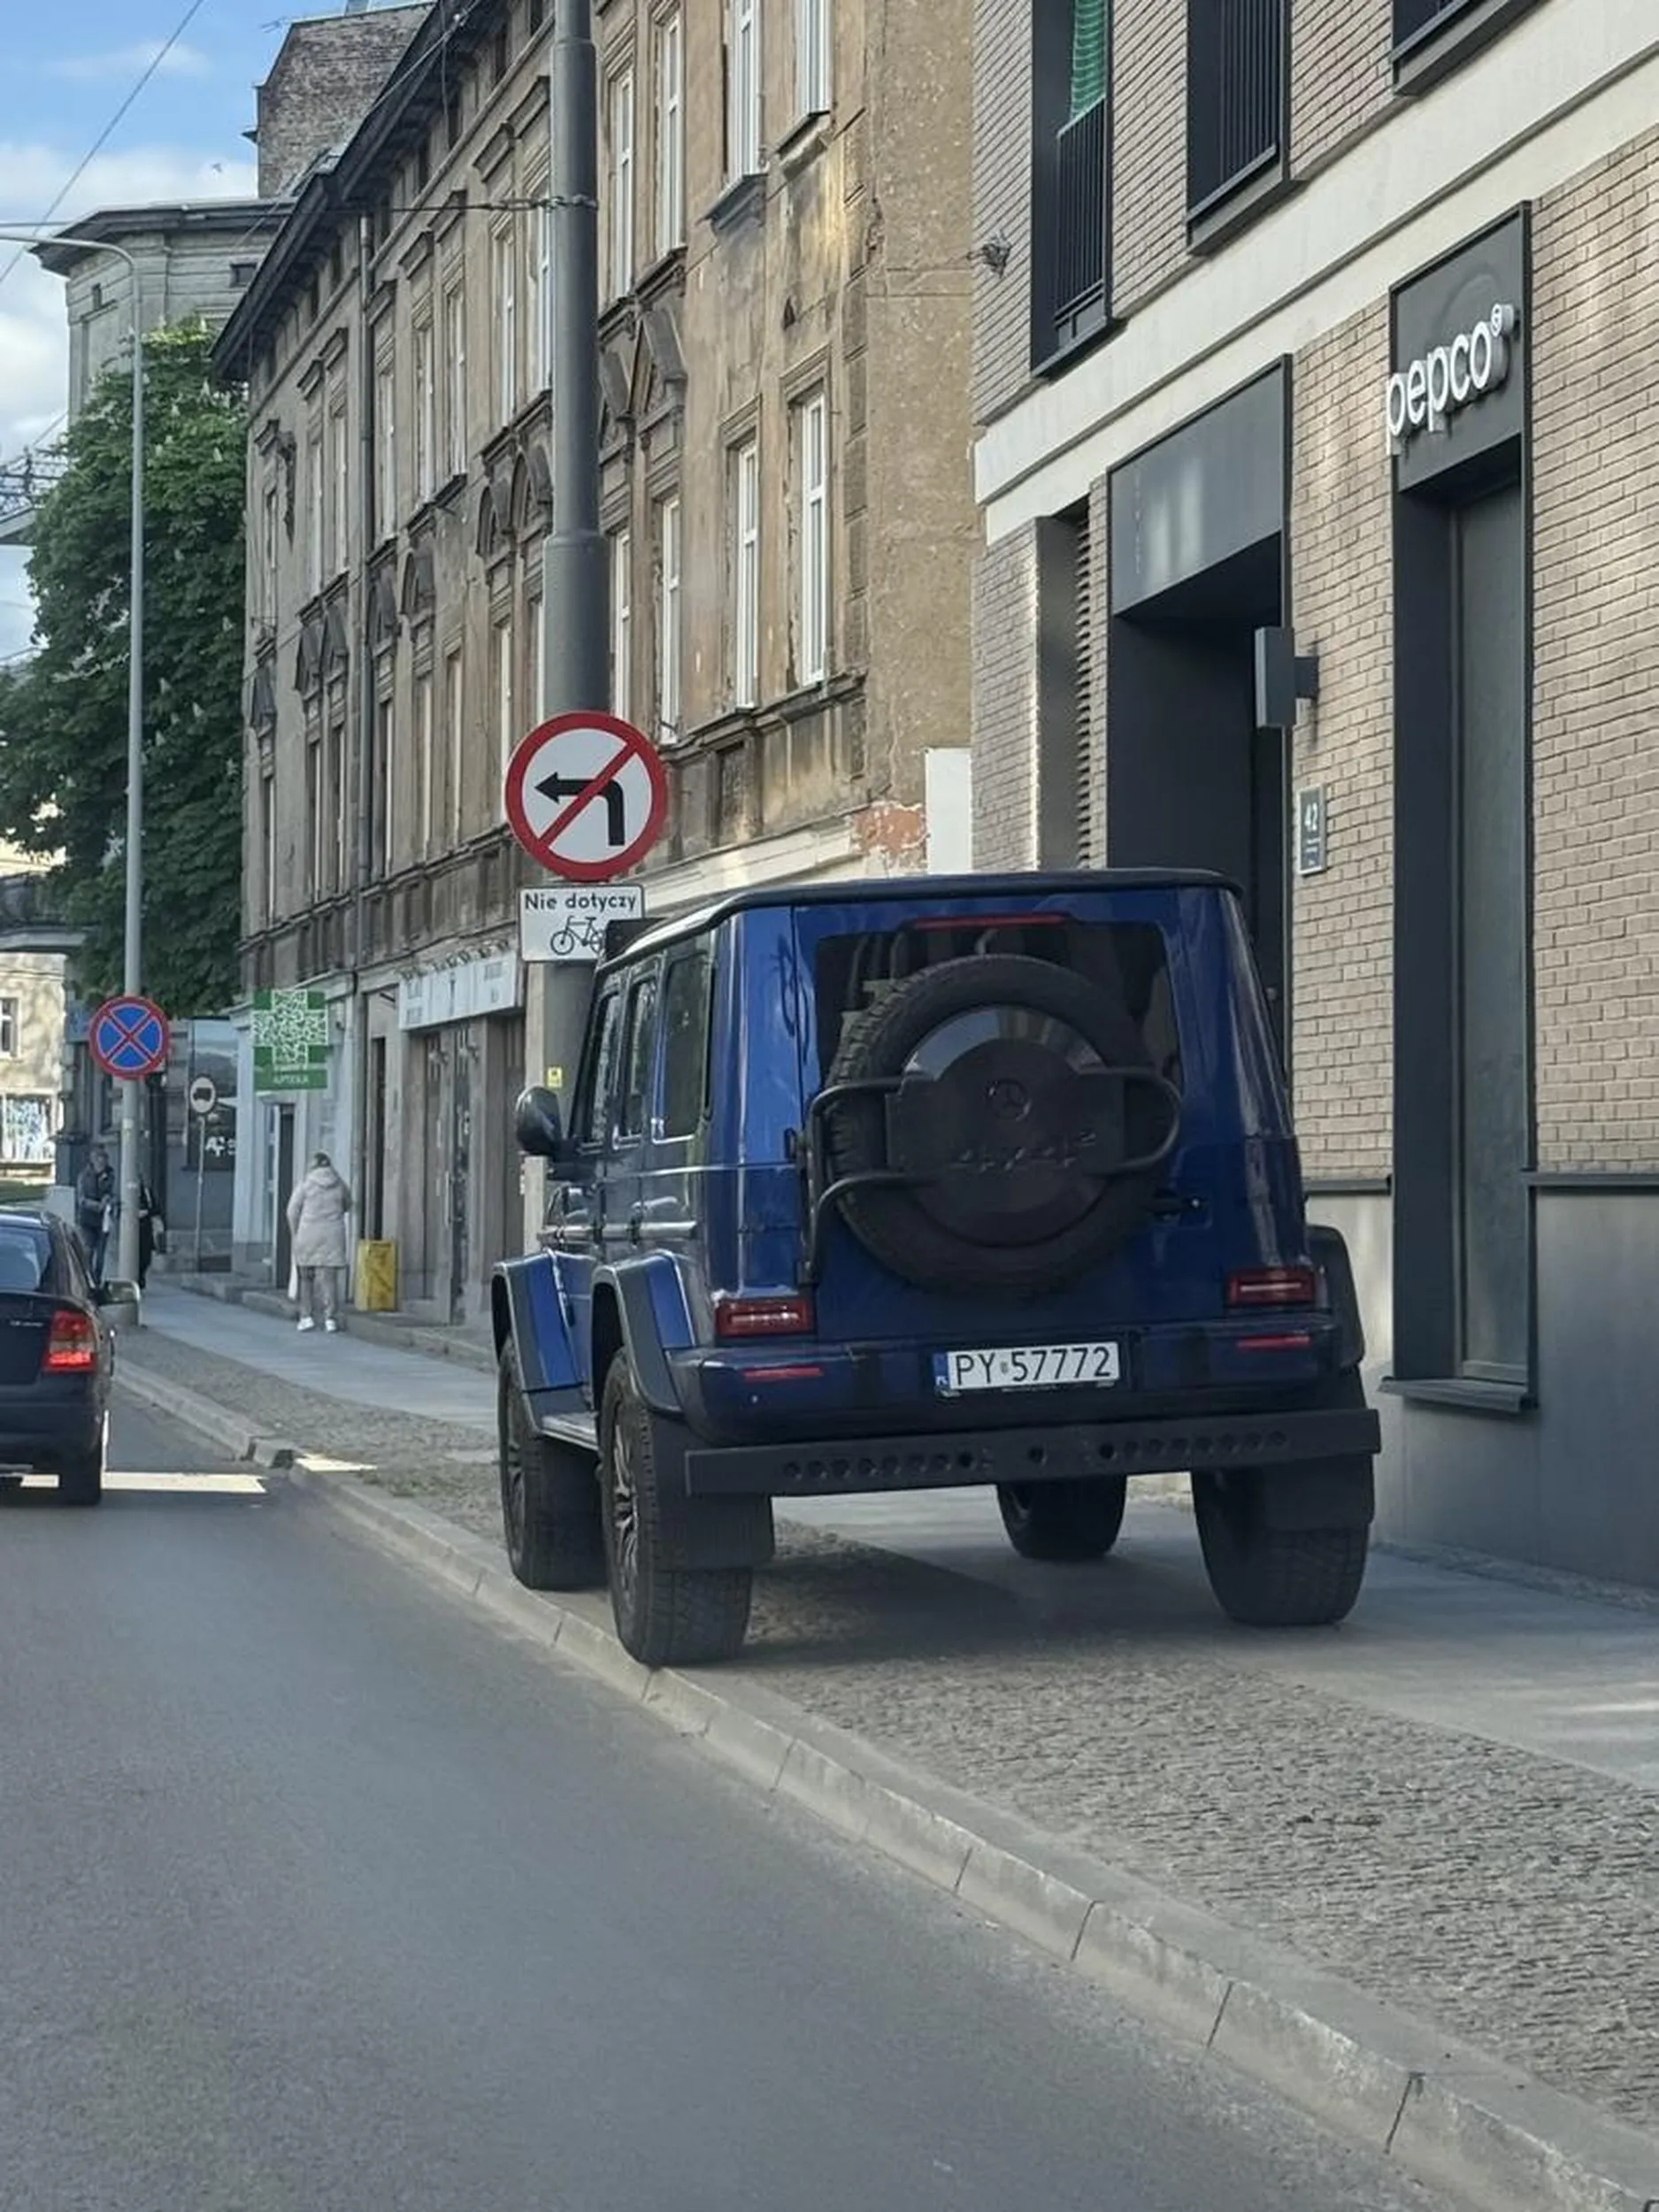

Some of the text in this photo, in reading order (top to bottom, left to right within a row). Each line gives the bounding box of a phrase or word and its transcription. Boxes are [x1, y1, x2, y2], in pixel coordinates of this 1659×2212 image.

[1386, 320, 1492, 456] pepco
[1305, 802, 1318, 832] 42
[525, 892, 636, 912] Nie dotyczy
[955, 1346, 1111, 1386] PY 57772
